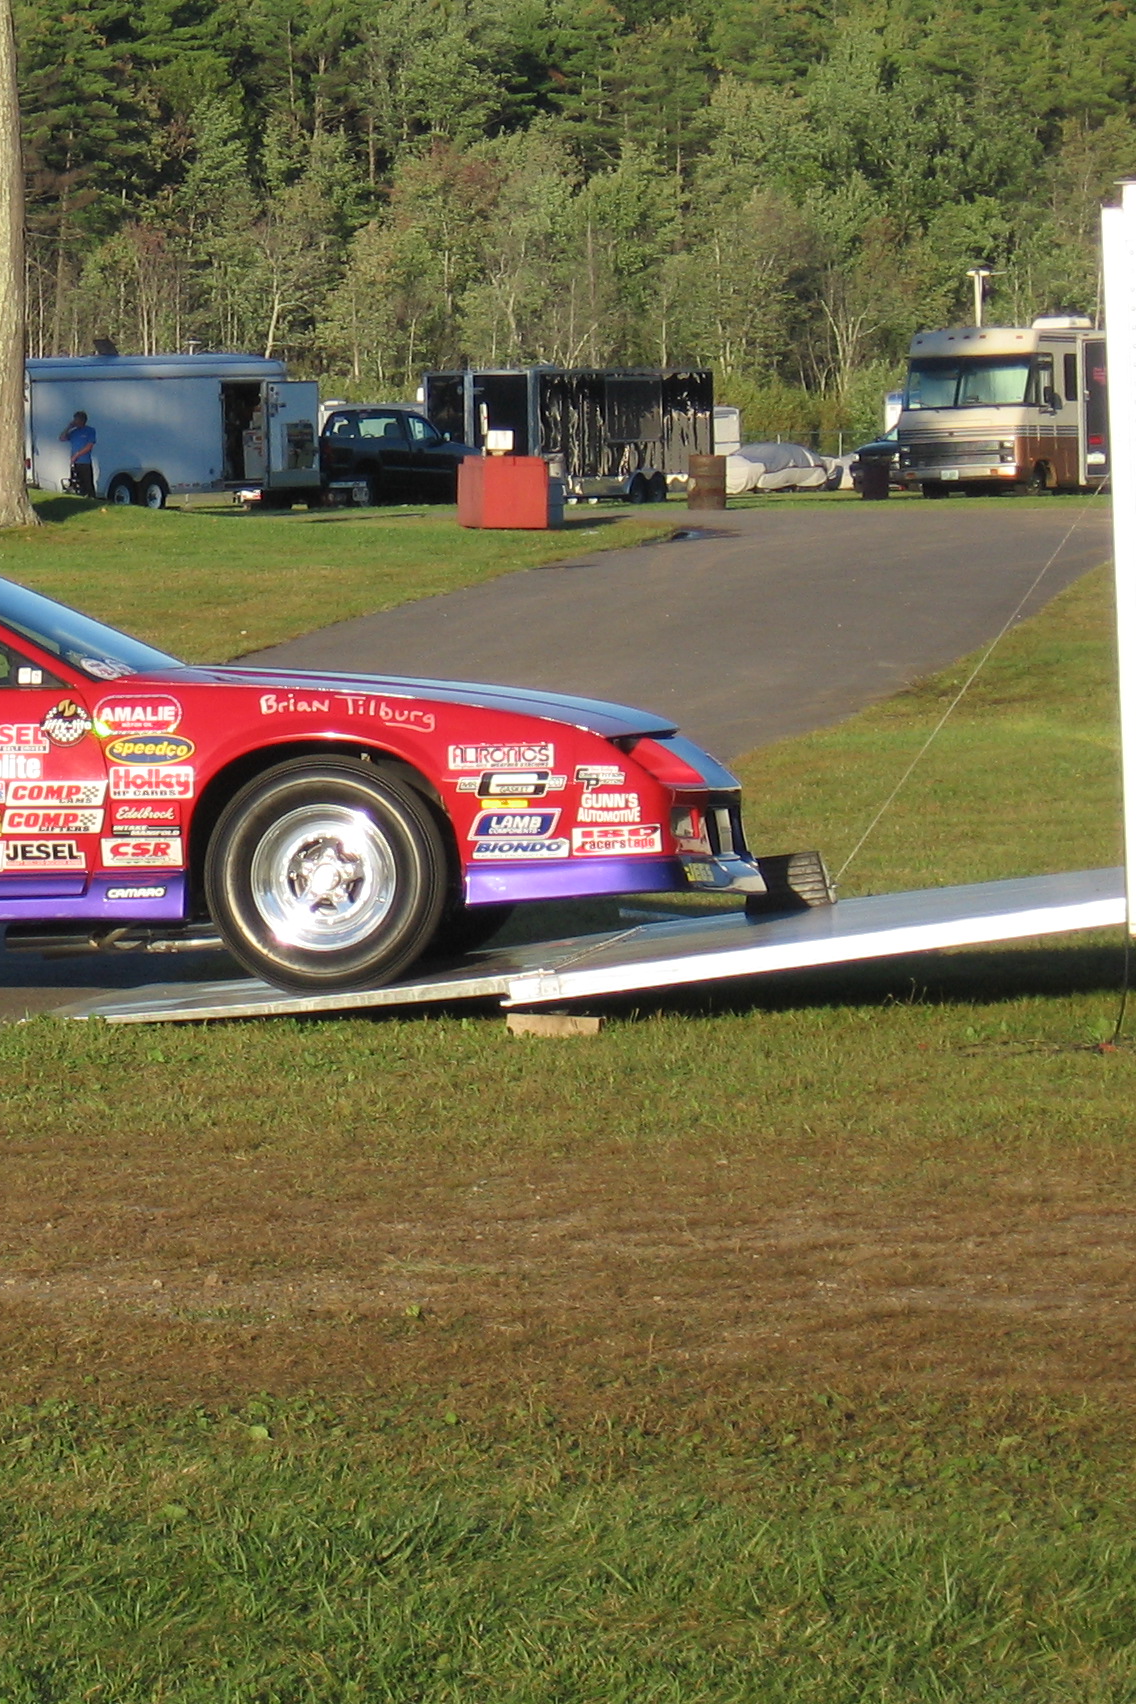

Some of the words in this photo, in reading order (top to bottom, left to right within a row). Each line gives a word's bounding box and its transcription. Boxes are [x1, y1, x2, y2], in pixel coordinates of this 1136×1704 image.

[100, 706, 176, 722] AMALIE
[334, 695, 436, 733] Tilburg
[114, 742, 188, 756] speedco
[114, 769, 190, 795] Holley
[12, 785, 81, 800] COMP
[581, 793, 639, 808] GUNN'S
[115, 806, 175, 819] Edelbrock
[577, 806, 641, 822] AUTOMOTIVE
[8, 813, 79, 828] COMP
[490, 816, 542, 828] LAMB
[5, 844, 79, 861] JESEL
[110, 843, 171, 856] CSR
[475, 842, 562, 853] BIONDO
[107, 887, 165, 898] CAMARO
